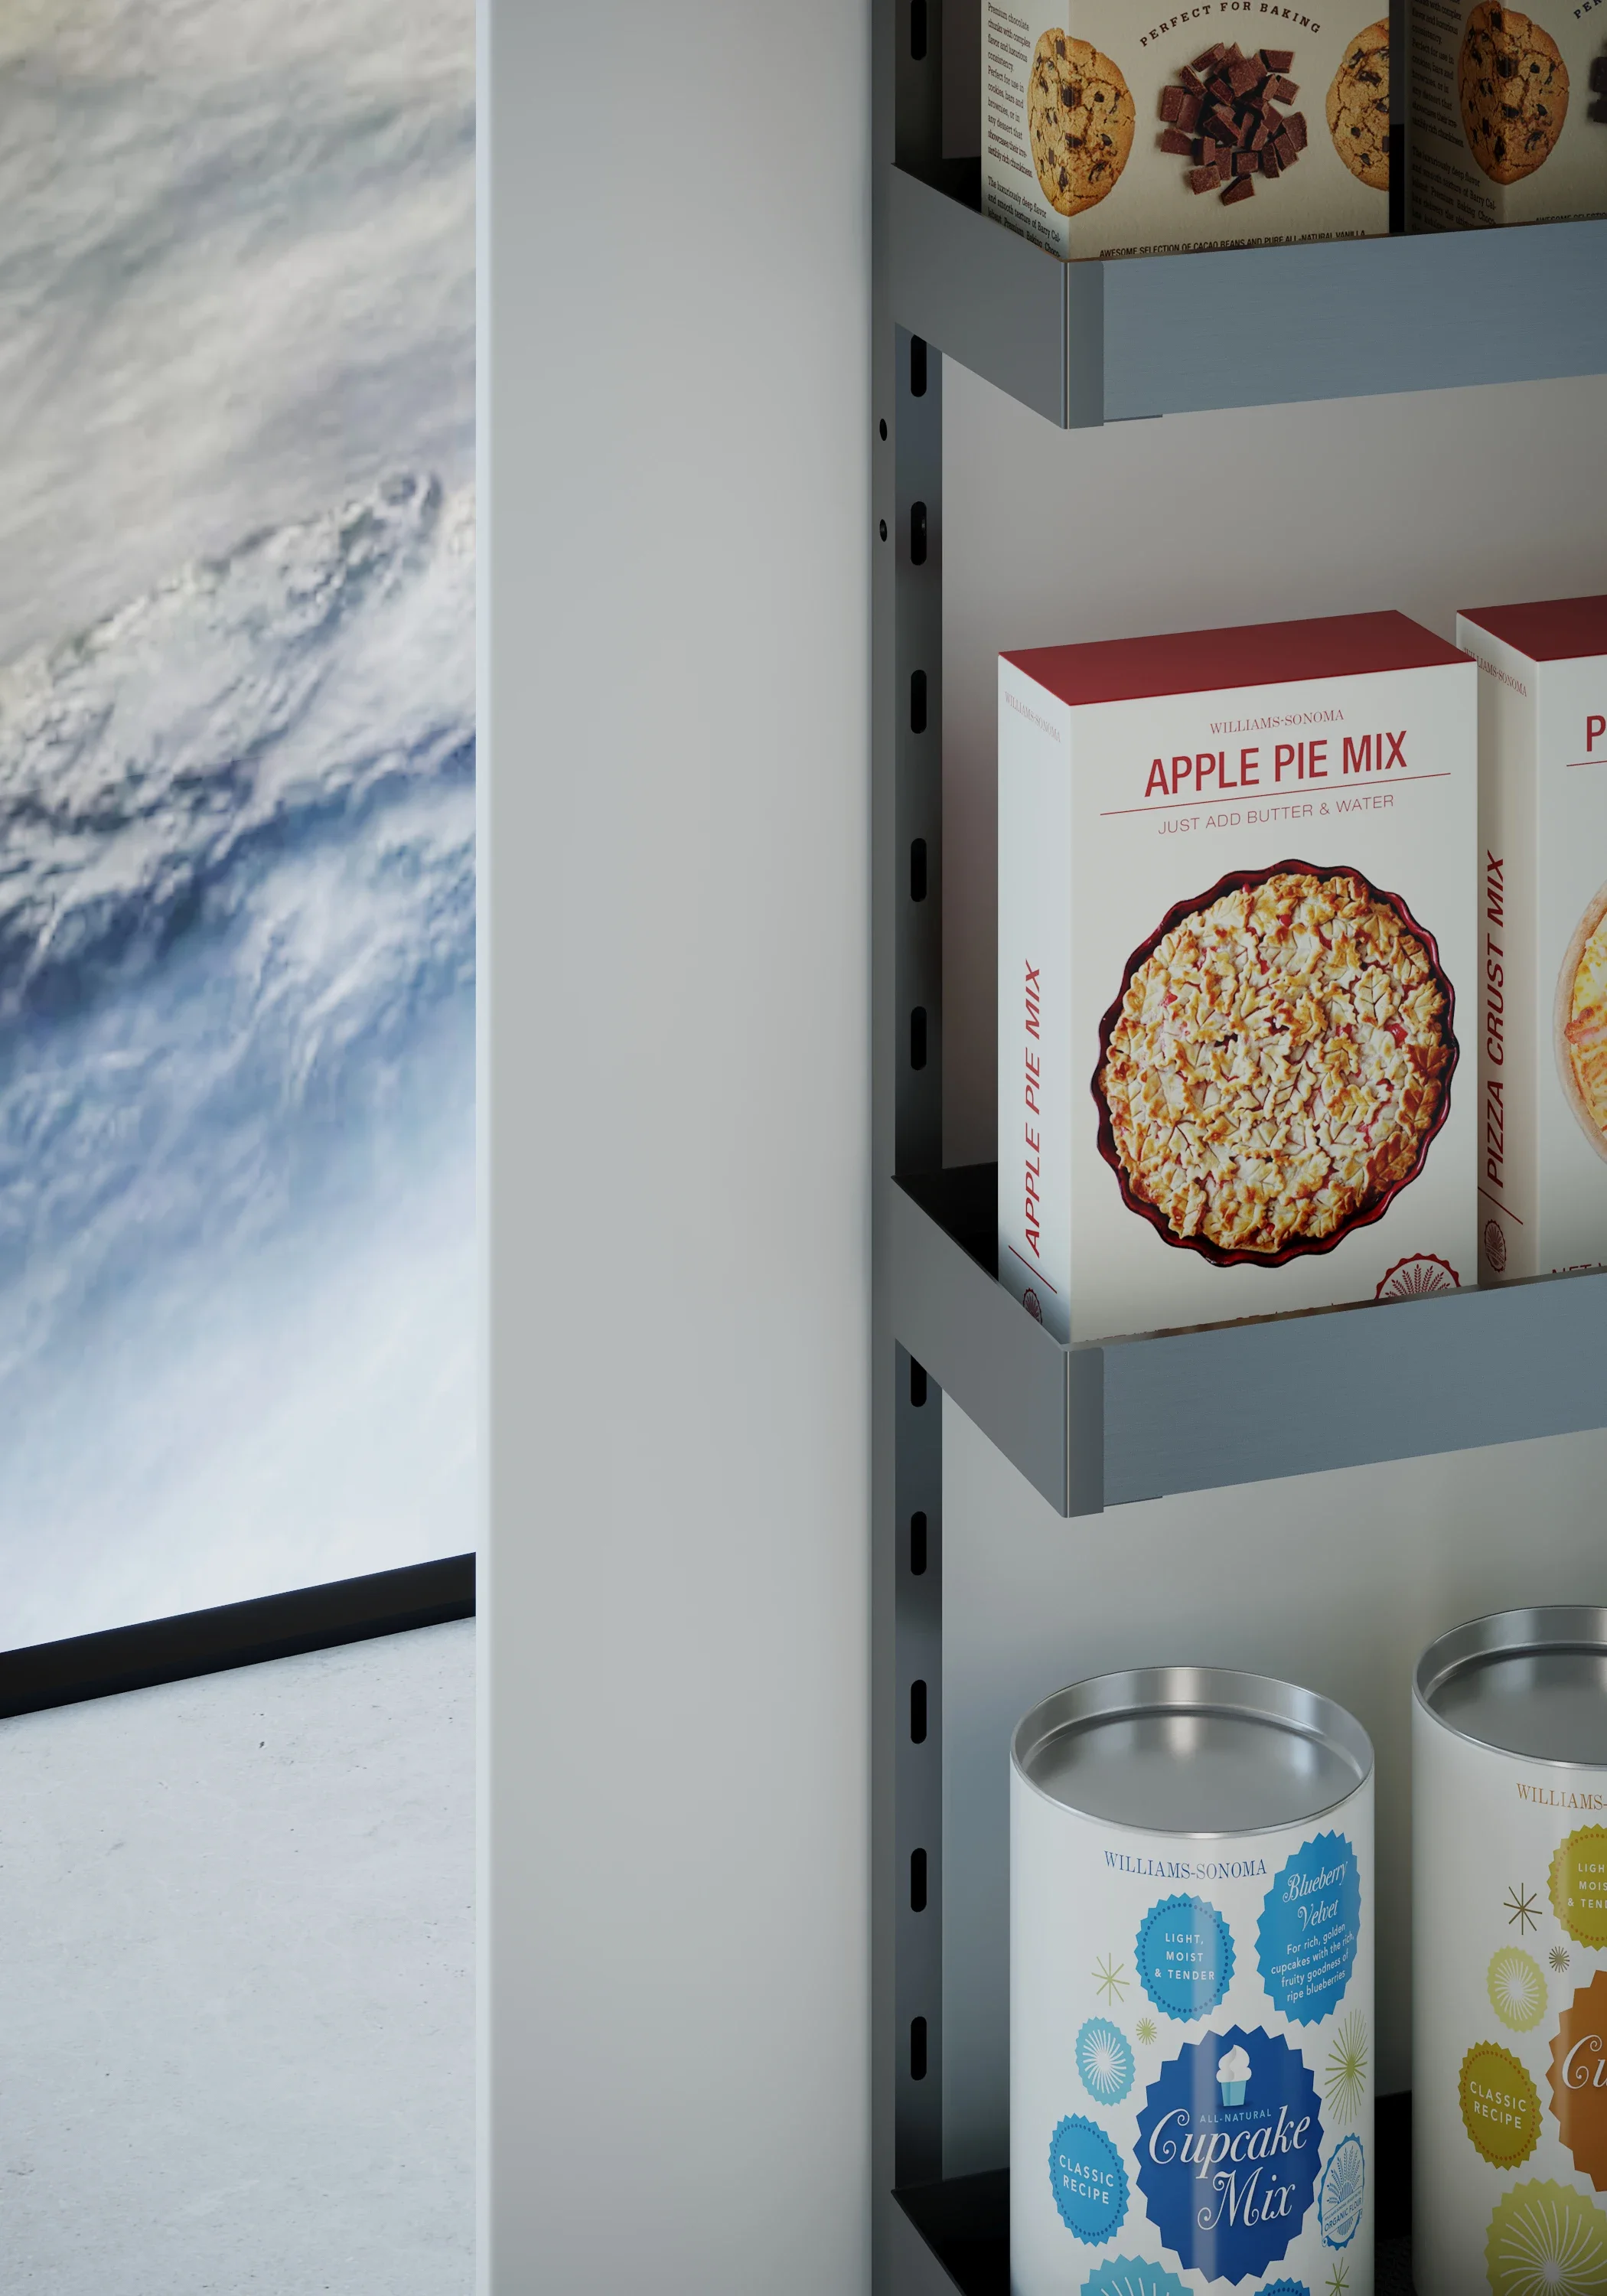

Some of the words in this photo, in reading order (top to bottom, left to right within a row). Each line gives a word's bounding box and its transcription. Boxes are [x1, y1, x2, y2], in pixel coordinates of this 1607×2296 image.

[988, 2, 1008, 20] Premium
[1009, 13, 1029, 31] chocolate
[988, 18, 1002, 34] chunks
[1003, 28, 1012, 39] with
[1013, 34, 1031, 48] complex
[1139, 5, 1211, 47] PERFECT
[1220, 2, 1252, 11] FOR
[1260, 2, 1321, 34] BAKING
[988, 34, 999, 47] flavor
[1009, 44, 1028, 63] luxurious
[988, 65, 1003, 82] Perfect
[1019, 82, 1024, 93] in
[988, 83, 1004, 99] cookies,
[1005, 90, 1015, 104] bars
[1015, 98, 1024, 109] and
[988, 96, 1009, 118] brownies,
[1010, 111, 1015, 119] or
[1015, 112, 1020, 123] in
[997, 118, 1012, 134] dessert
[1013, 128, 1022, 140] that
[988, 175, 996, 188] The
[997, 181, 1022, 205] luxuriously
[1022, 197, 1033, 212] deep
[1033, 203, 1047, 218] flavor
[988, 194, 996, 204] and
[997, 199, 1014, 215] smooth
[1015, 208, 1031, 225] texture
[1032, 219, 1037, 229] of
[1038, 221, 1051, 239] Barry
[1051, 230, 1061, 243] Cal-
[1005, 691, 1061, 743] WILLIAMS-SONOMA
[1210, 709, 1345, 735] WILLIAMS-SONOMA
[1145, 748, 1260, 797] APPLE
[1275, 739, 1328, 782] PIE
[1343, 730, 1407, 775] MIX
[1158, 817, 1200, 835] JUST
[1205, 812, 1241, 829] ADD
[1247, 804, 1313, 824] BUTTER
[1319, 802, 1330, 816] &
[1335, 794, 1394, 814] WATER
[1487, 849, 1504, 928] MIX
[1025, 957, 1040, 1040] MIX
[1487, 931, 1504, 1066] CRUST
[1025, 1047, 1040, 1116] PIE
[1487, 1080, 1504, 1189] PIZZA
[1025, 1121, 1040, 1259] APPLE
[1103, 1850, 1267, 1880] WILLIAMS-SONOMA
[1578, 1863, 1605, 1874] LIGH
[1282, 1861, 1348, 1903] Blueberry
[1297, 1899, 1339, 1932] Velvet
[1567, 1897, 1575, 1907] &
[1165, 1932, 1204, 1945] LIGHT,
[1286, 1943, 1302, 1955] For
[1304, 1935, 1321, 1950] rich,
[1322, 1923, 1346, 1945] golden
[1165, 1951, 1204, 1962] MOIST
[1270, 1956, 1311, 1976] cupcakes
[1312, 1946, 1328, 1962] with
[1330, 1941, 1341, 1955] the
[1281, 1973, 1305, 1988] fruity
[1307, 1958, 1341, 1983] goodness
[1341, 1948, 1349, 1962] of
[1154, 1968, 1162, 1978] &
[1167, 1969, 1215, 1981] TENDER
[1286, 1991, 1305, 2004] ripe
[1306, 1969, 1345, 1996] blueberries
[1469, 2080, 1527, 2113] CLASSIC
[1199, 2108, 1272, 2123] ALL-NATURAL
[1474, 2100, 1522, 2130] RECIPE
[1149, 2104, 1311, 2180] Cupcake
[1059, 2154, 1114, 2187] CLASSIC
[1063, 2174, 1110, 2205] RECIPE
[1197, 2166, 1296, 2231] Mix
[1325, 2207, 1348, 2232] ORGANIC
[1349, 2197, 1362, 2213] FLOUR
